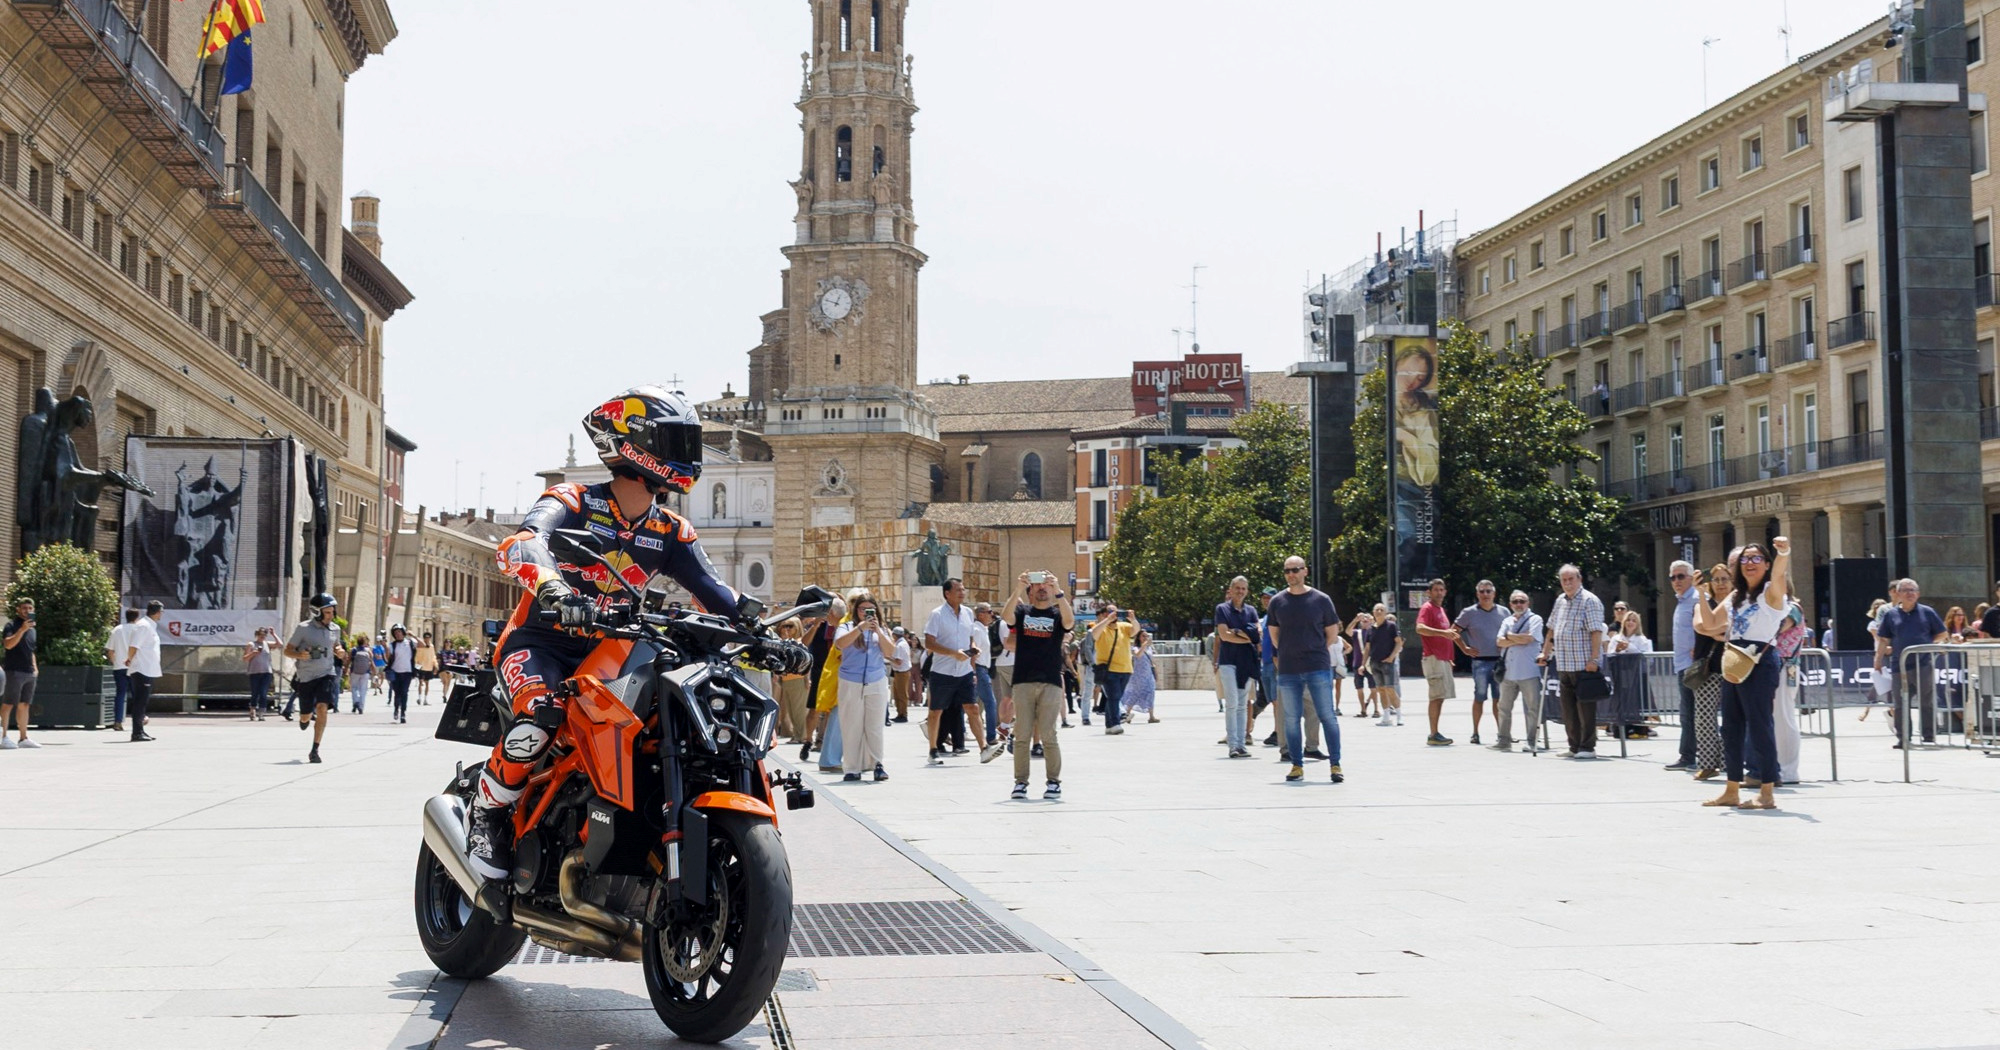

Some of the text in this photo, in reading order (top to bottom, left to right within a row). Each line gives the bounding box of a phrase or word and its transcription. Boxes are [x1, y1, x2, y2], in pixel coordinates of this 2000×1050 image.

[1185, 363, 1242, 380] HOTEL
[620, 441, 672, 479] Red Bull
[1110, 455, 1119, 513] HOTEL
[1416, 510, 1424, 544] MUSEO
[636, 535, 656, 548] Mobil
[184, 623, 235, 635] Zaragoza
[501, 649, 543, 699] Red
[591, 810, 611, 825] KTM
